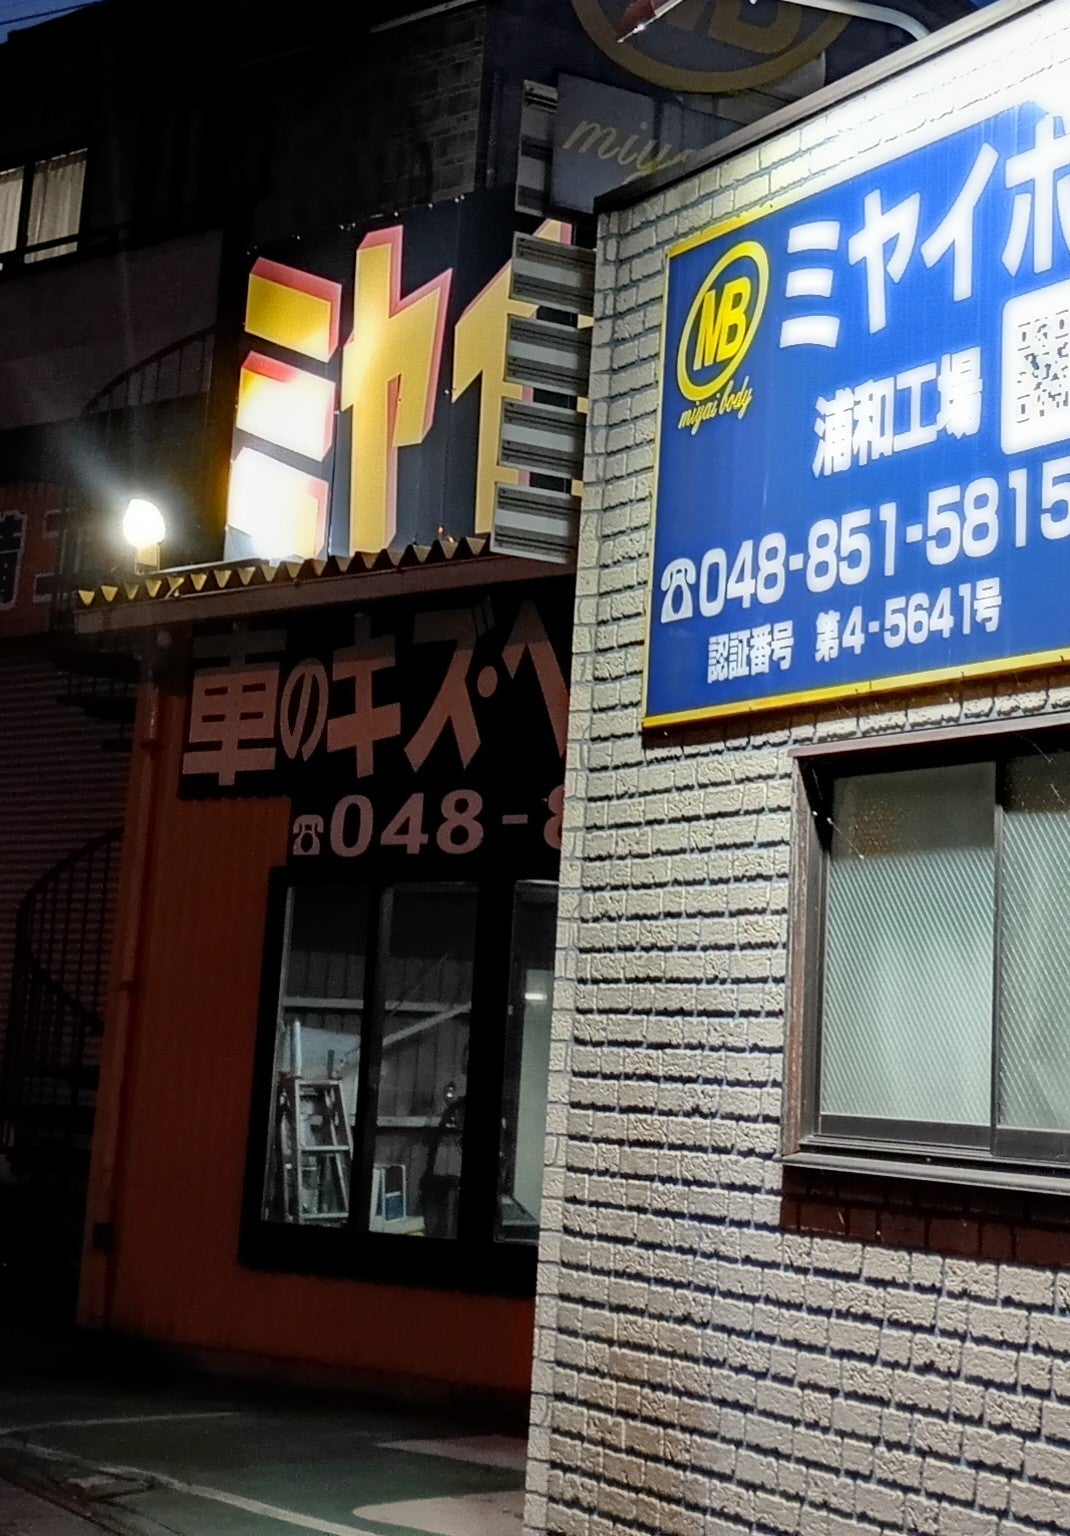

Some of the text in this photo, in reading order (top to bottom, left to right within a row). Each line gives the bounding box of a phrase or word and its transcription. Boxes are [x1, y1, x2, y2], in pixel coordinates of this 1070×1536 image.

[693, 276, 751, 371] MB
[227, 224, 595, 561] ミヤイ
[719, 375, 753, 419] body
[812, 346, 983, 478] 浦和工場
[707, 577, 1002, 684] 認証番号 第4-5641号
